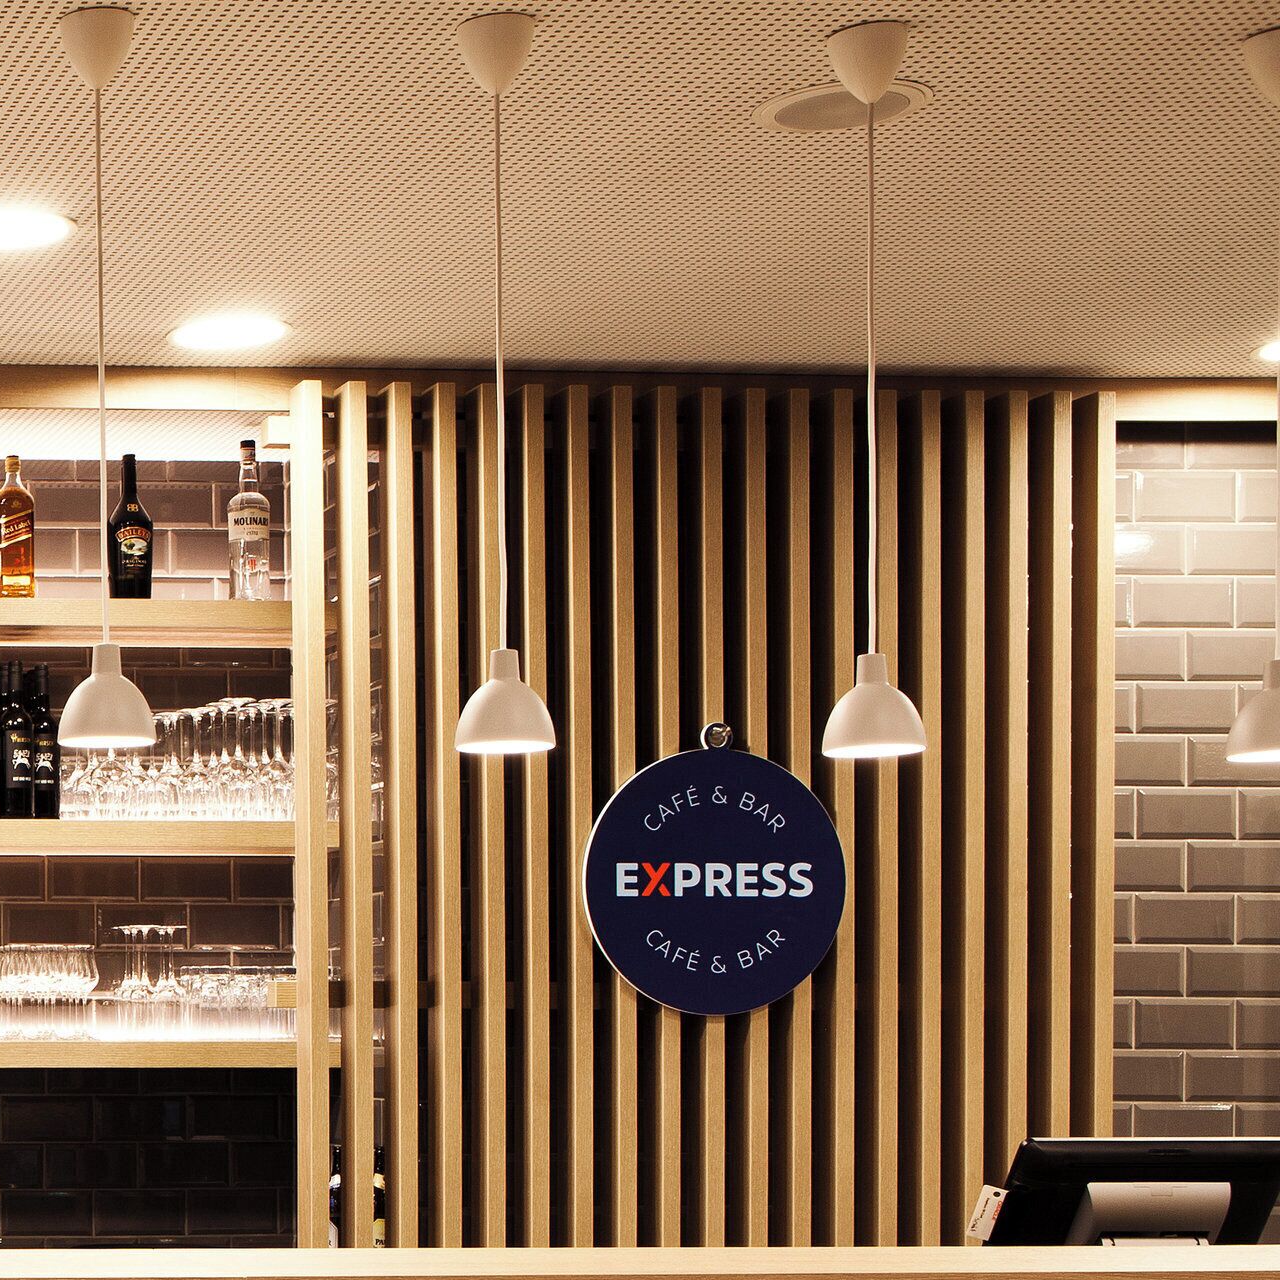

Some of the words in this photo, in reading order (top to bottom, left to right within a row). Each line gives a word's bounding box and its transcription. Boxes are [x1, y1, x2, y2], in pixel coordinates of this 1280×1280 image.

[643, 785, 700, 831] CAFÉ
[711, 785, 727, 804] &
[739, 791, 786, 833] BAR
[615, 862, 814, 897] EXPRESS
[646, 929, 701, 971] CAFÉ
[710, 955, 727, 974] &
[736, 929, 786, 969] BAR
